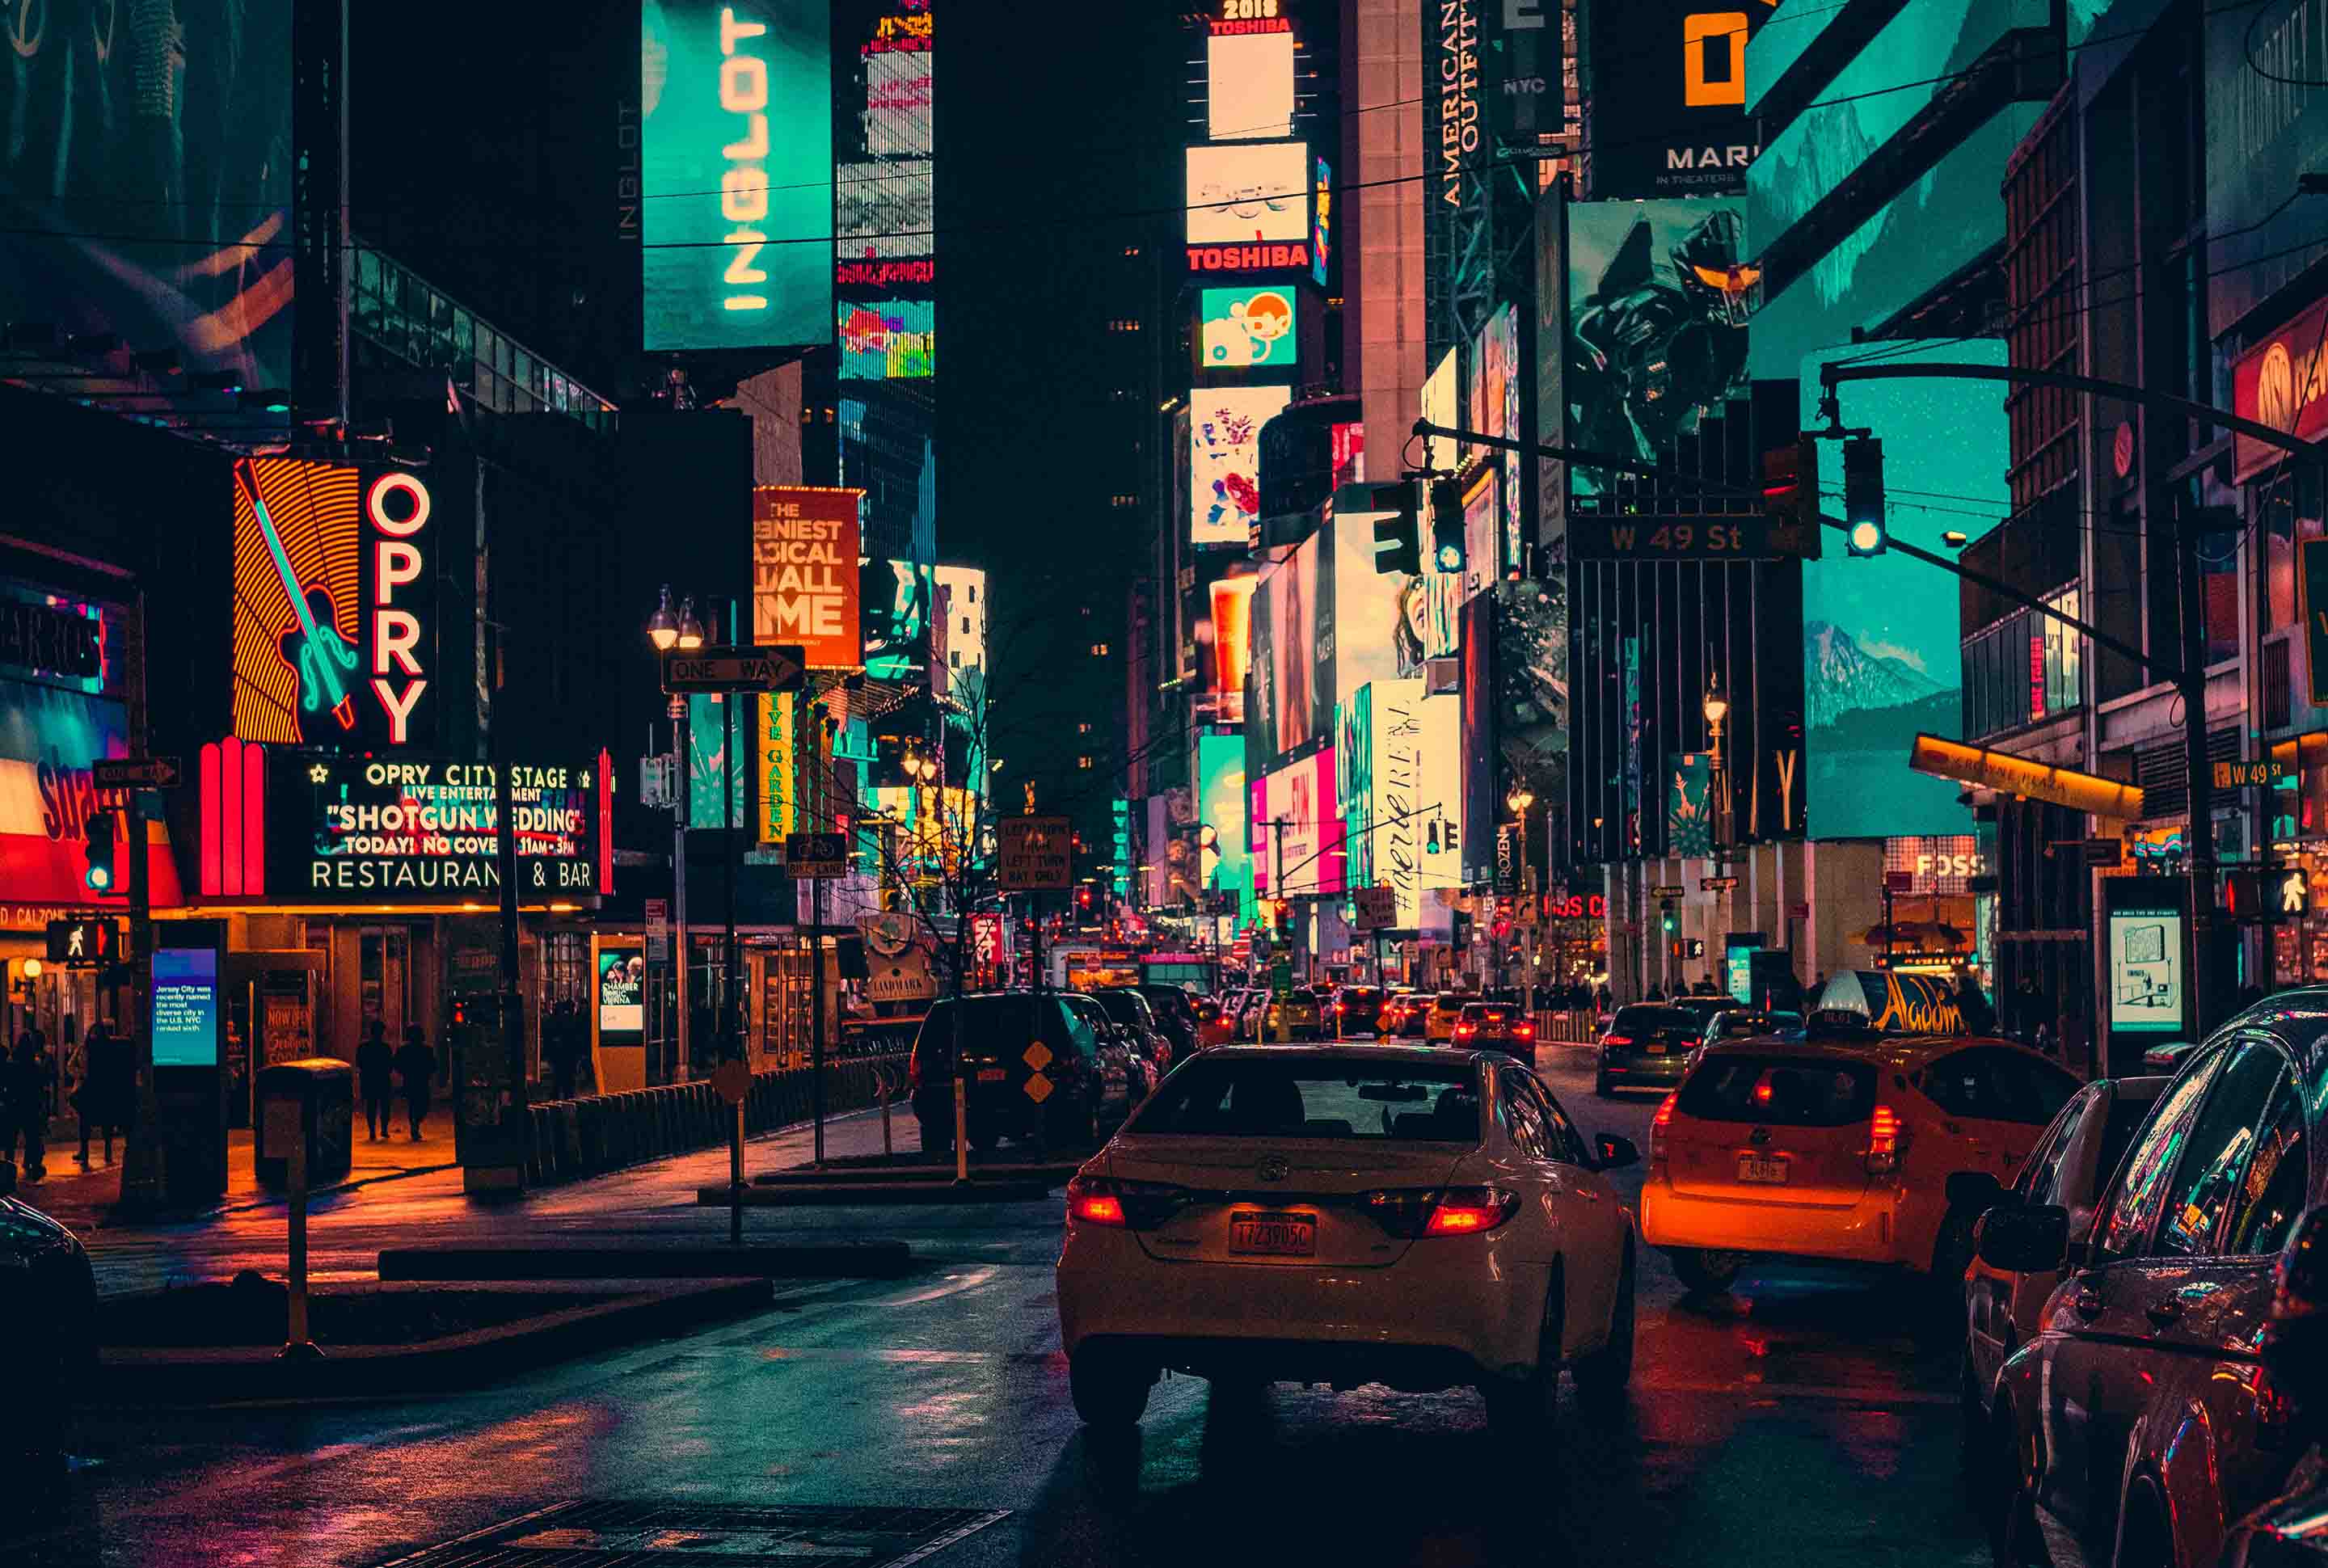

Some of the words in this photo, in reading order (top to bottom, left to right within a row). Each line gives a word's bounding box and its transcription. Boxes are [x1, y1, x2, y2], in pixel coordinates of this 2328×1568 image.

[1209, 18, 1292, 36] TOSHIBA
[1504, 78, 1546, 95] NYC
[719, 7, 770, 310] INGLOT
[1667, 145, 1760, 170] MAR
[617, 101, 639, 241] INGLOT
[1187, 246, 1310, 271] TOSHIBA
[1611, 524, 1637, 550] W
[1650, 523, 1694, 550] 49
[1706, 524, 1745, 550] St
[366, 473, 432, 744] OPRY
[676, 662, 716, 677] ONE
[745, 660, 784, 677] WAY
[366, 764, 430, 785] OPRY
[445, 765, 496, 786] CITY
[511, 766, 567, 789] STAGE
[2233, 765, 2246, 783] W
[2250, 764, 2267, 784] 49
[403, 786, 435, 800] LIVE
[439, 786, 542, 802] ENTERTAMENT
[768, 749, 783, 837] GARDEN
[327, 805, 478, 831] "SHOTGUN
[344, 837, 415, 854] TODAY!
[423, 837, 452, 854] NO
[453, 837, 498, 854] COVE
[312, 861, 501, 887] RESTAURAN
[534, 862, 546, 887] &
[559, 862, 590, 887] BAR
[181, 984, 196, 995] City
[602, 983, 639, 992] CHAMBER
[183, 1009, 196, 1018] city
